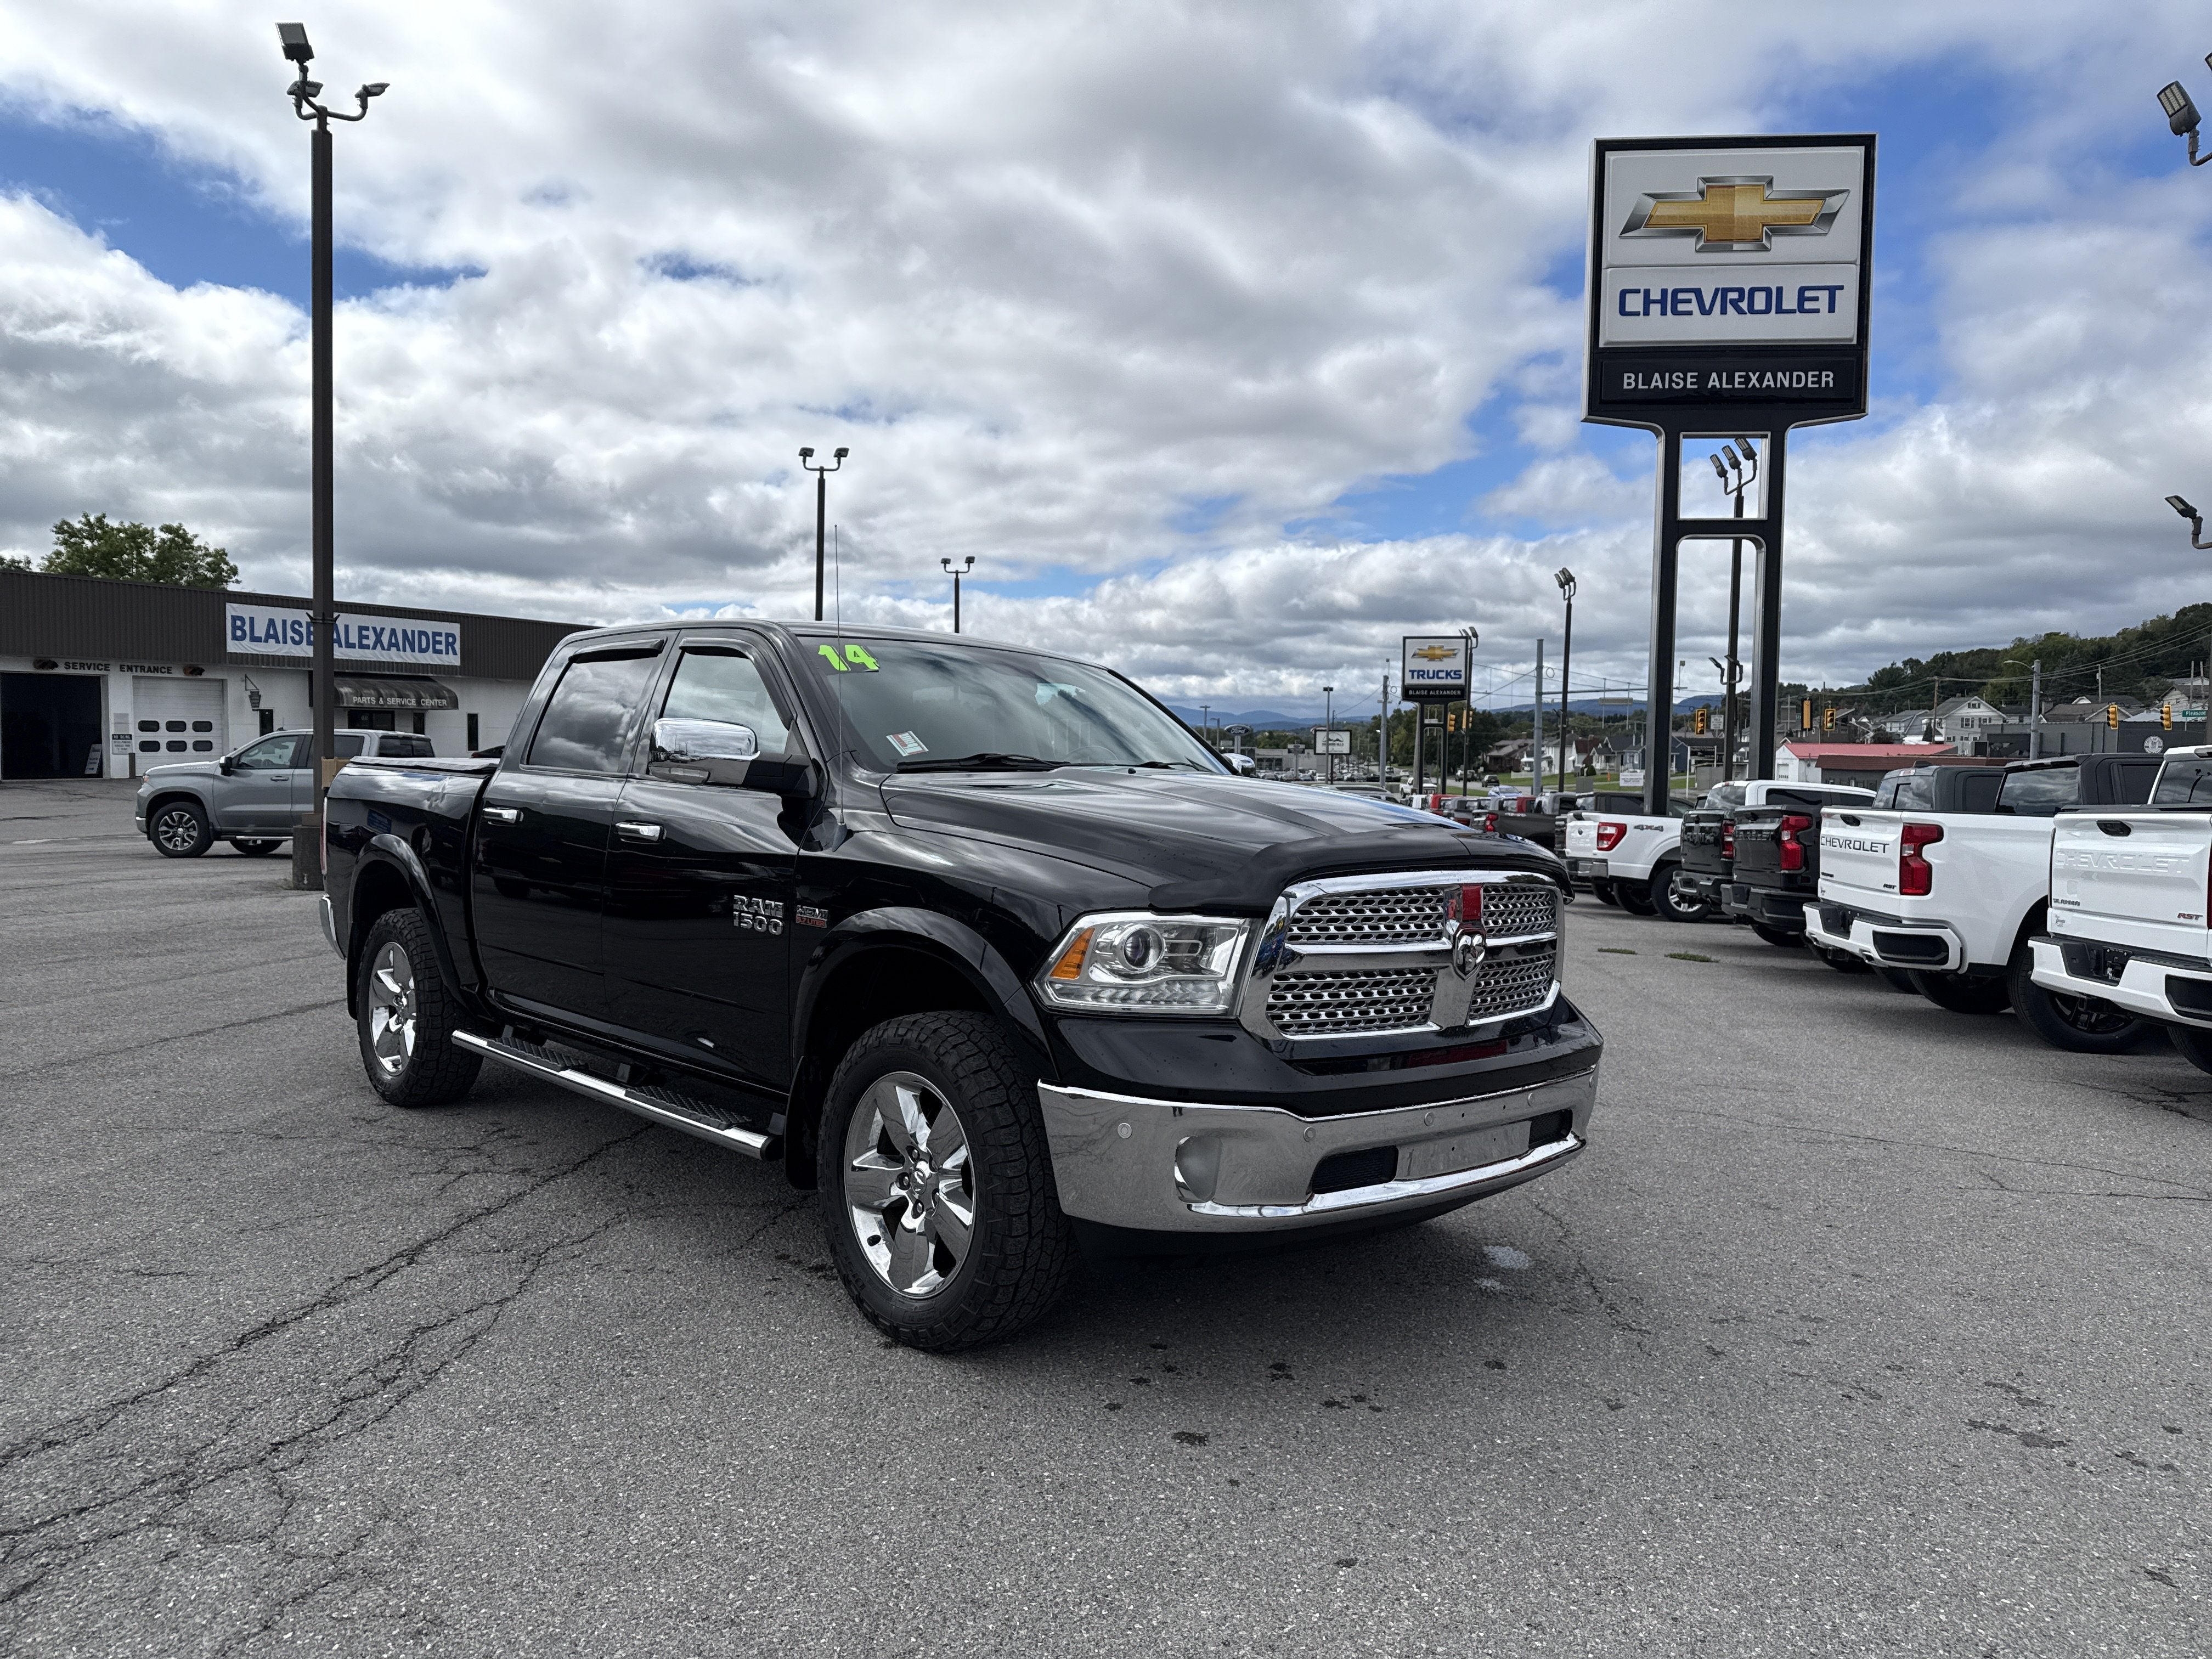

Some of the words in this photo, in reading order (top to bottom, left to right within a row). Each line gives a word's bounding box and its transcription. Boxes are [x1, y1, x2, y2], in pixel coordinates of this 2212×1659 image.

[1618, 285, 1844, 317] CHEVROLET
[1623, 372, 1699, 390] BLAISE
[1707, 371, 1834, 389] ALEXANDER
[230, 614, 313, 646] BLAISE
[333, 623, 458, 656] ALEXANDER
[818, 645, 881, 671] 14
[64, 662, 110, 672] SERVICE
[120, 664, 173, 674] ENTRANCE
[1409, 670, 1462, 679] TRUCKS
[387, 697, 416, 706] SERVICE
[1820, 836, 1889, 854] CHEVROLET
[733, 895, 784, 918] RAM
[733, 911, 784, 935] 1500
[2177, 912, 2203, 921] RST
